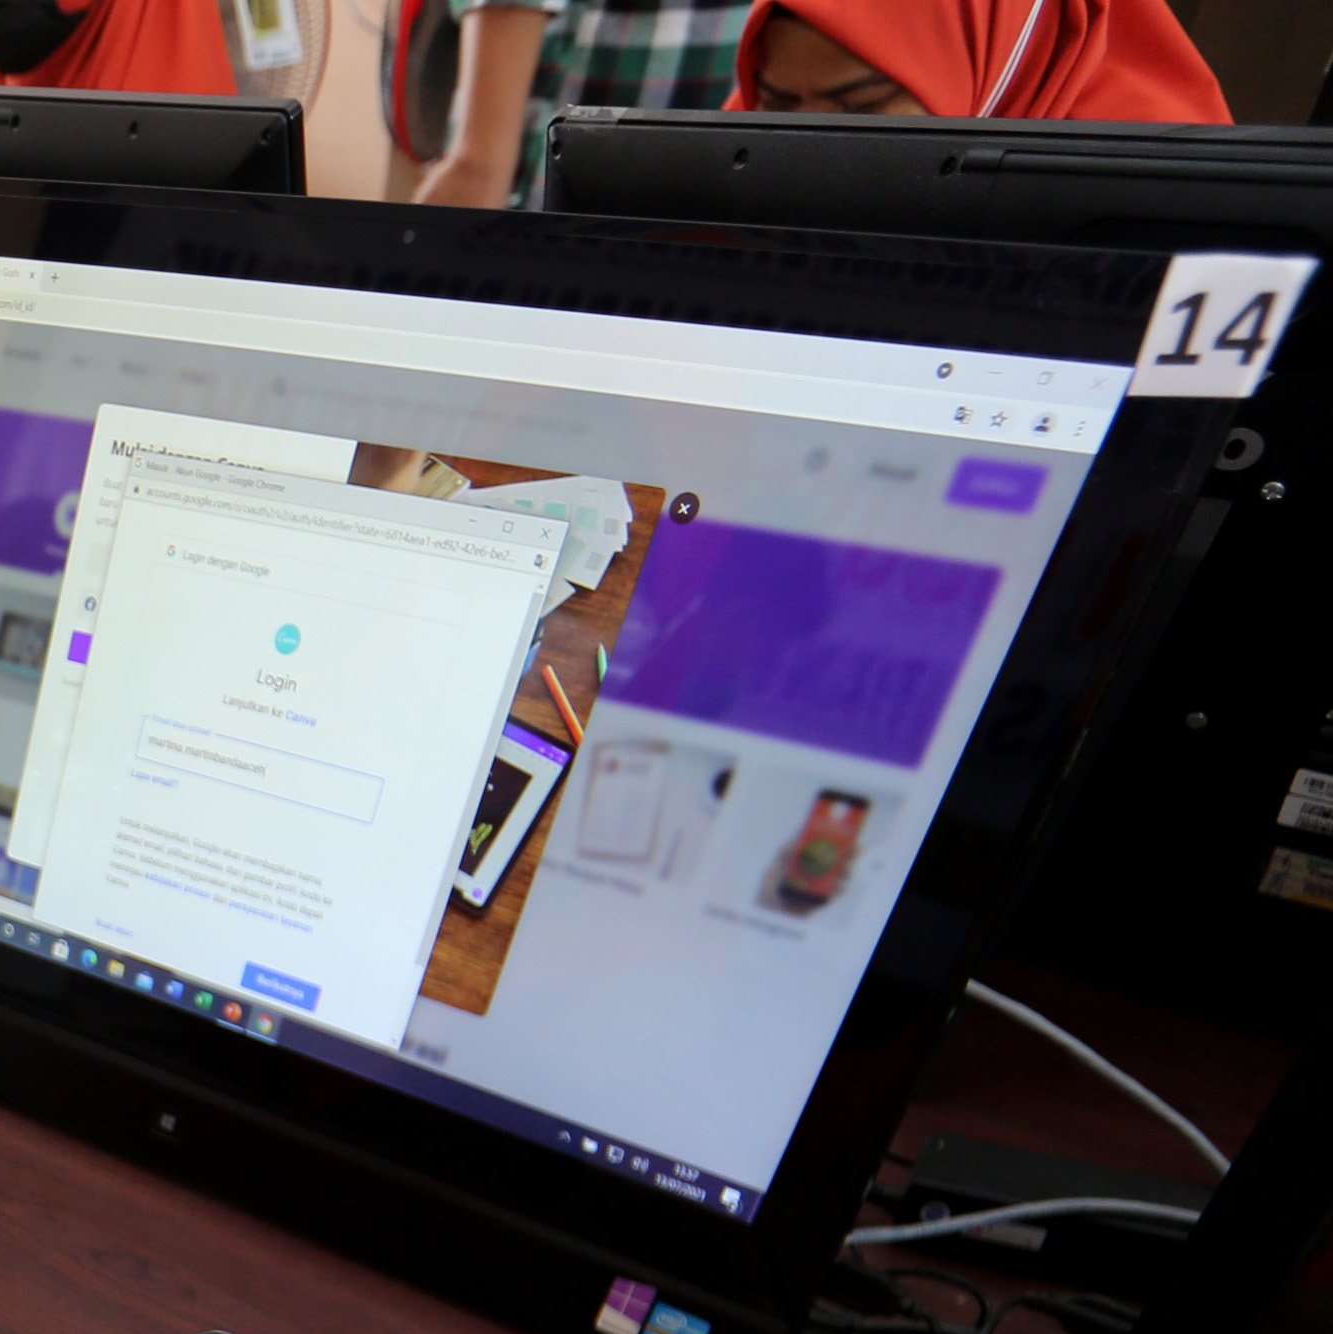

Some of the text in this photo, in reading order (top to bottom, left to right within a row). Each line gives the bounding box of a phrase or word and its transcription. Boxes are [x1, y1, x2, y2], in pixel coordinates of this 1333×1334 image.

[1155, 291, 1279, 366] 14
[256, 668, 299, 693] Login
[222, 693, 317, 728] Lanjutkan ke Canva
